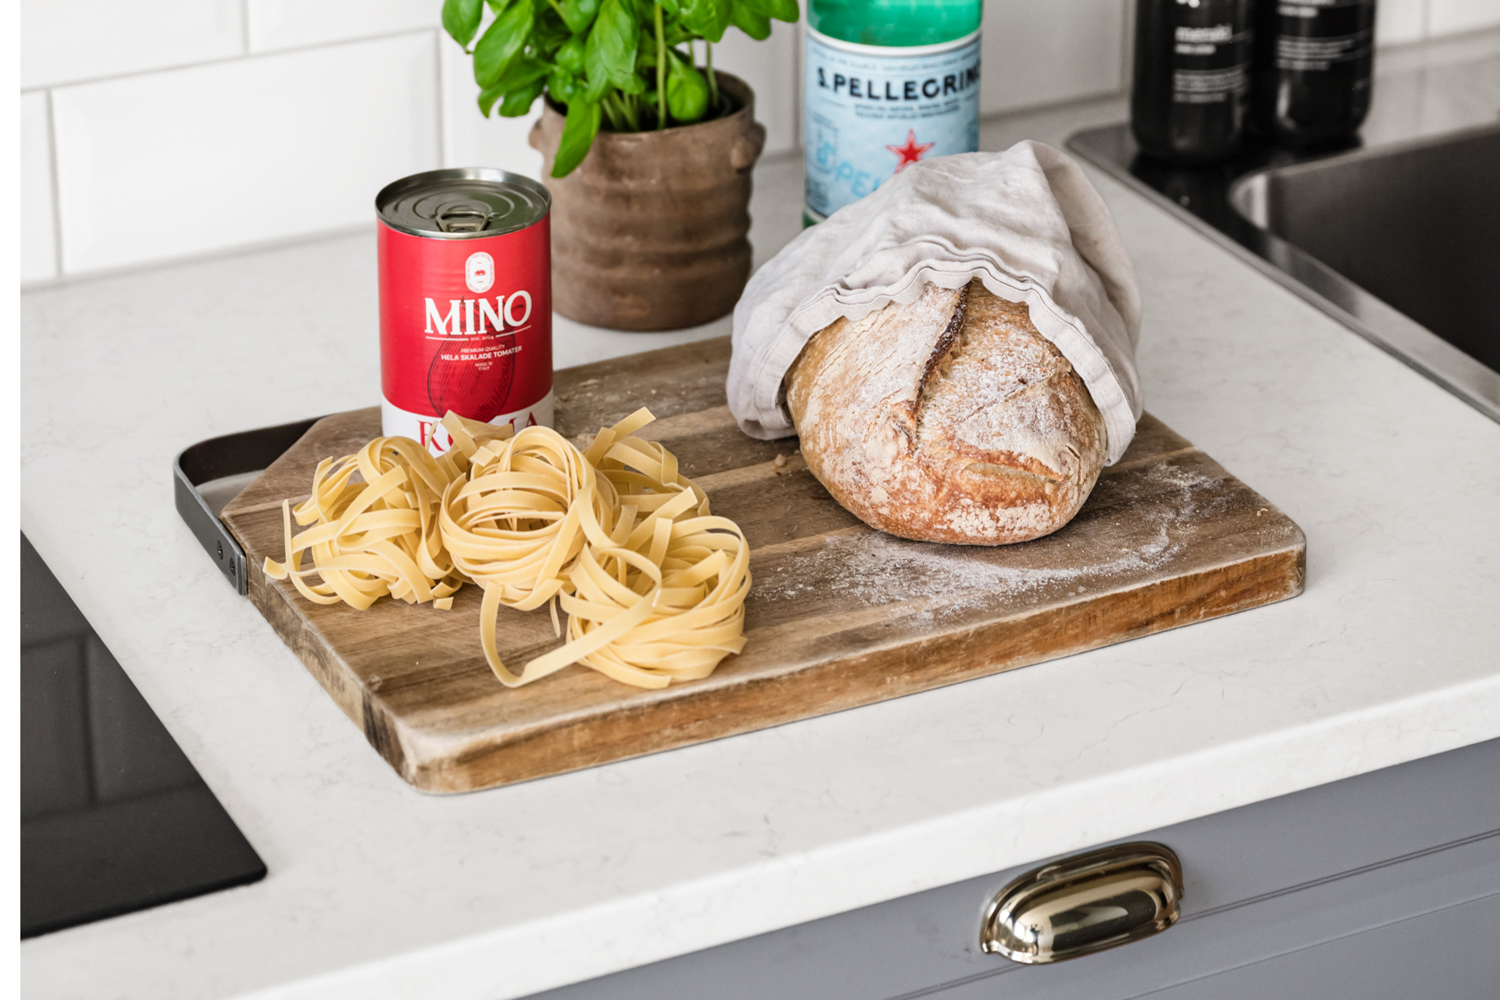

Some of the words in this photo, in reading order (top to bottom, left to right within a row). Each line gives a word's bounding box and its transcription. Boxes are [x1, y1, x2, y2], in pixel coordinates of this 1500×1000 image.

[817, 59, 980, 100] S.PELLEGRIN
[424, 290, 532, 335] MINO
[460, 352, 492, 361] SKALADE
[493, 345, 522, 358] TOMATER
[485, 344, 506, 352] QUALITY
